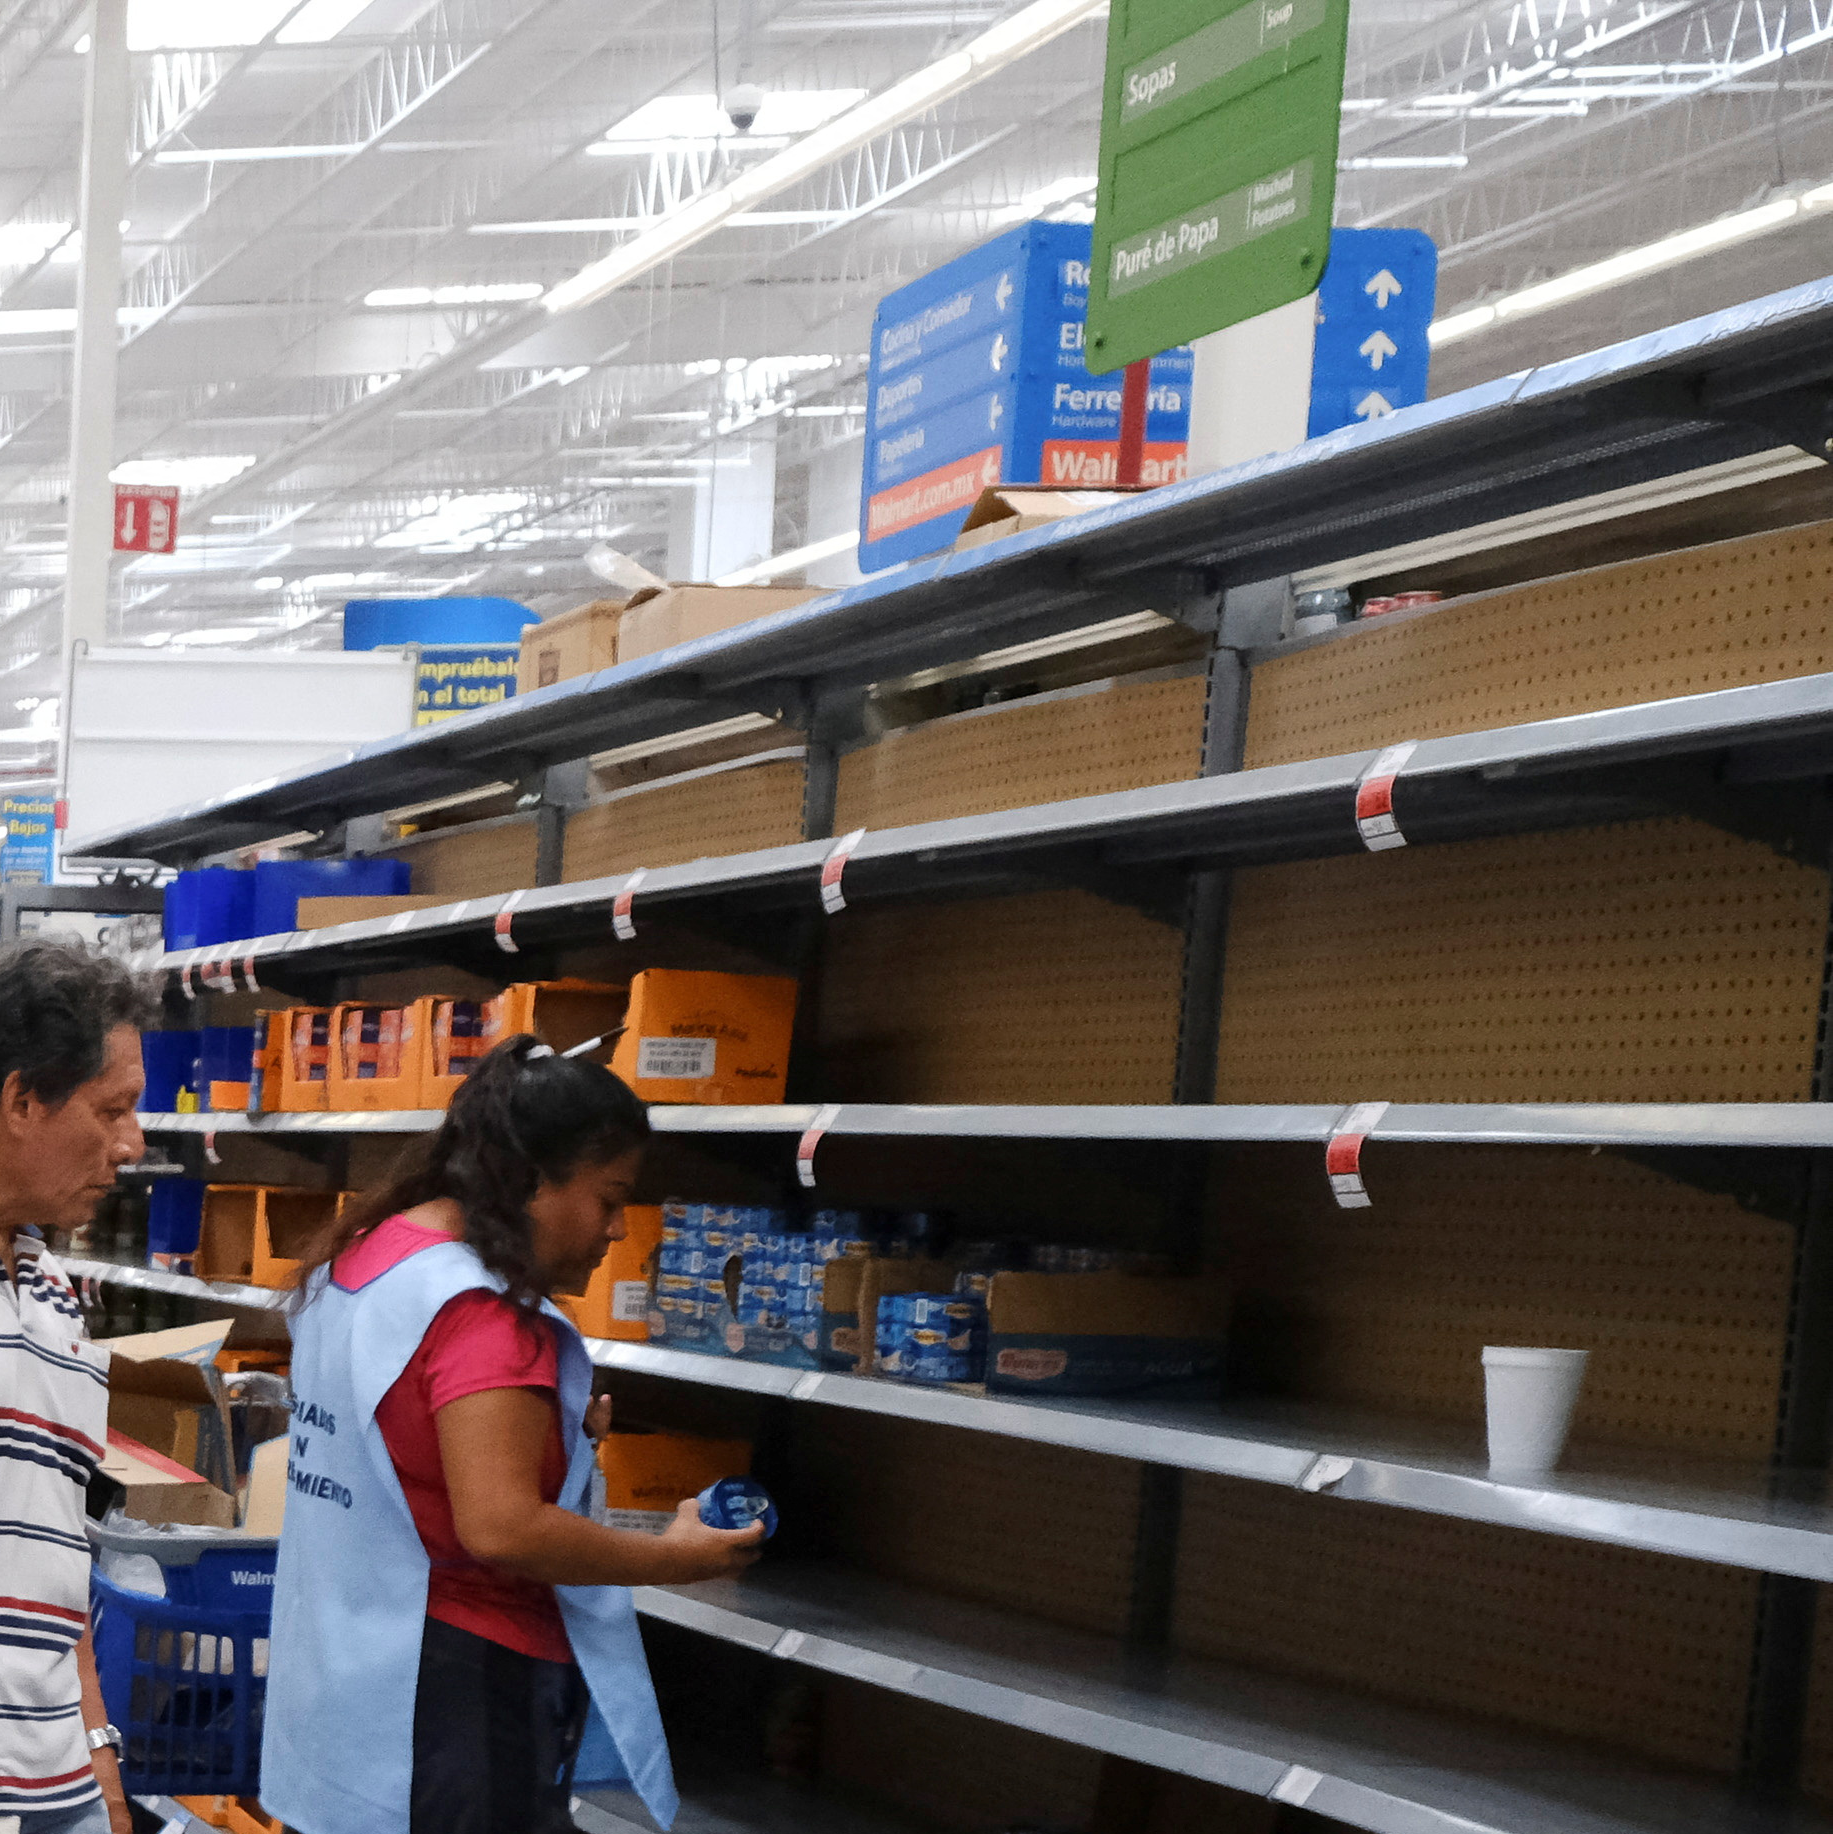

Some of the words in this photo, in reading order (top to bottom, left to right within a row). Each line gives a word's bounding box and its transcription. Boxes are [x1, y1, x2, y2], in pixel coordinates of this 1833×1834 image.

[1129, 61, 1177, 105] Sopas
[1115, 239, 1151, 280] Puré
[1155, 231, 1175, 261] de
[1179, 217, 1219, 254] Papa
[1054, 382, 1182, 412] Ferrería
[1051, 450, 1188, 483] Walart
[419, 656, 519, 683] mpruébal
[434, 684, 452, 704] el
[458, 683, 506, 705] total
[231, 1570, 276, 1586] Walm
